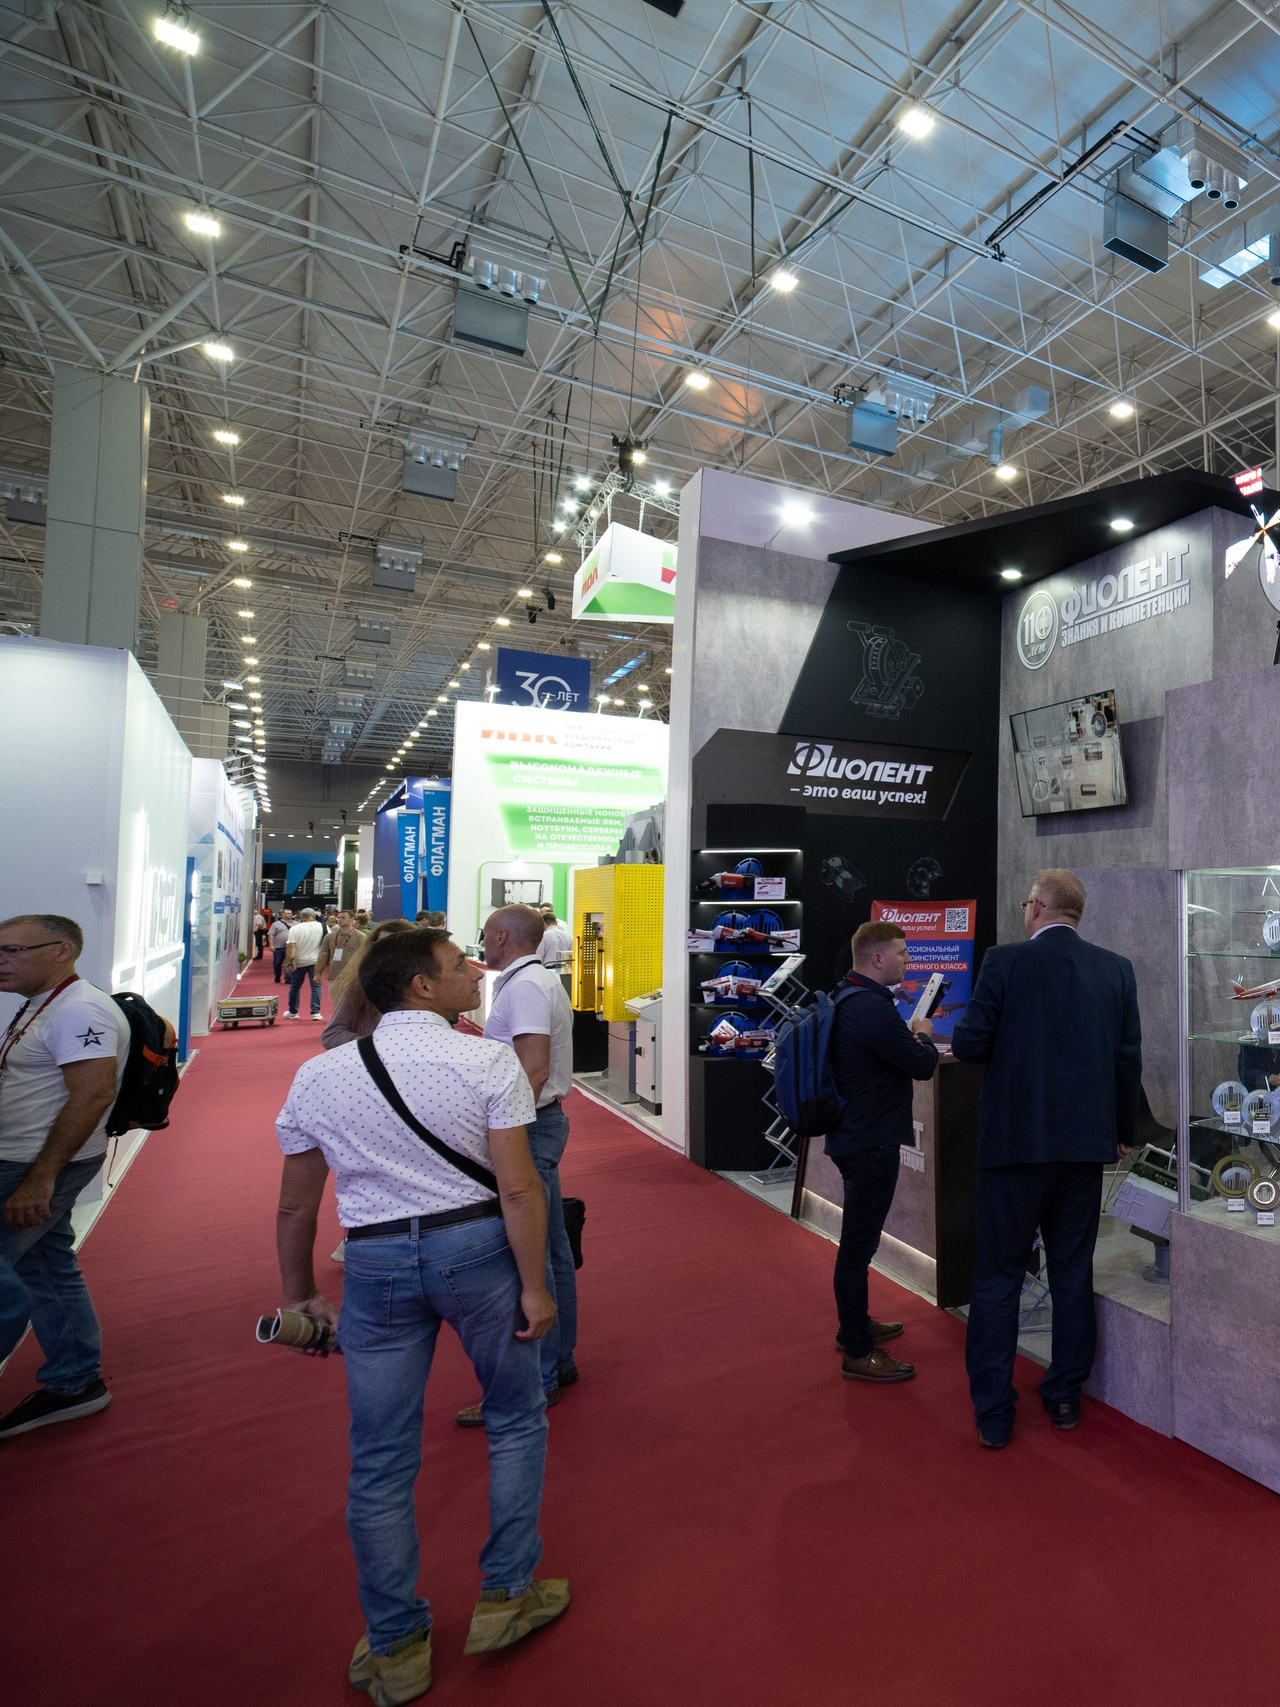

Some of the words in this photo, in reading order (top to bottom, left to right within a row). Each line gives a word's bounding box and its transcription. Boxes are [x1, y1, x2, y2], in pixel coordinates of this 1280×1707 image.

[1061, 617, 1099, 647] ЗНАНИЯ
[1101, 613, 1108, 634] И
[1109, 585, 1191, 631] КОМПЕТЕНЦИИ
[556, 691, 580, 702] ЛЕТ
[513, 774, 579, 787] СИСТЕМЫ
[803, 785, 838, 798] это
[842, 788, 877, 801] ваш
[878, 791, 927, 805] успех!
[528, 815, 600, 825] ВСТРАИВАЕМЫЕ
[582, 826, 623, 835] СЕРВЕРЫ
[431, 807, 446, 877] ФЛАГМАН
[546, 842, 612, 851] ПРОЦЕССОРАХ
[404, 826, 416, 883] ФЛАГМАН
